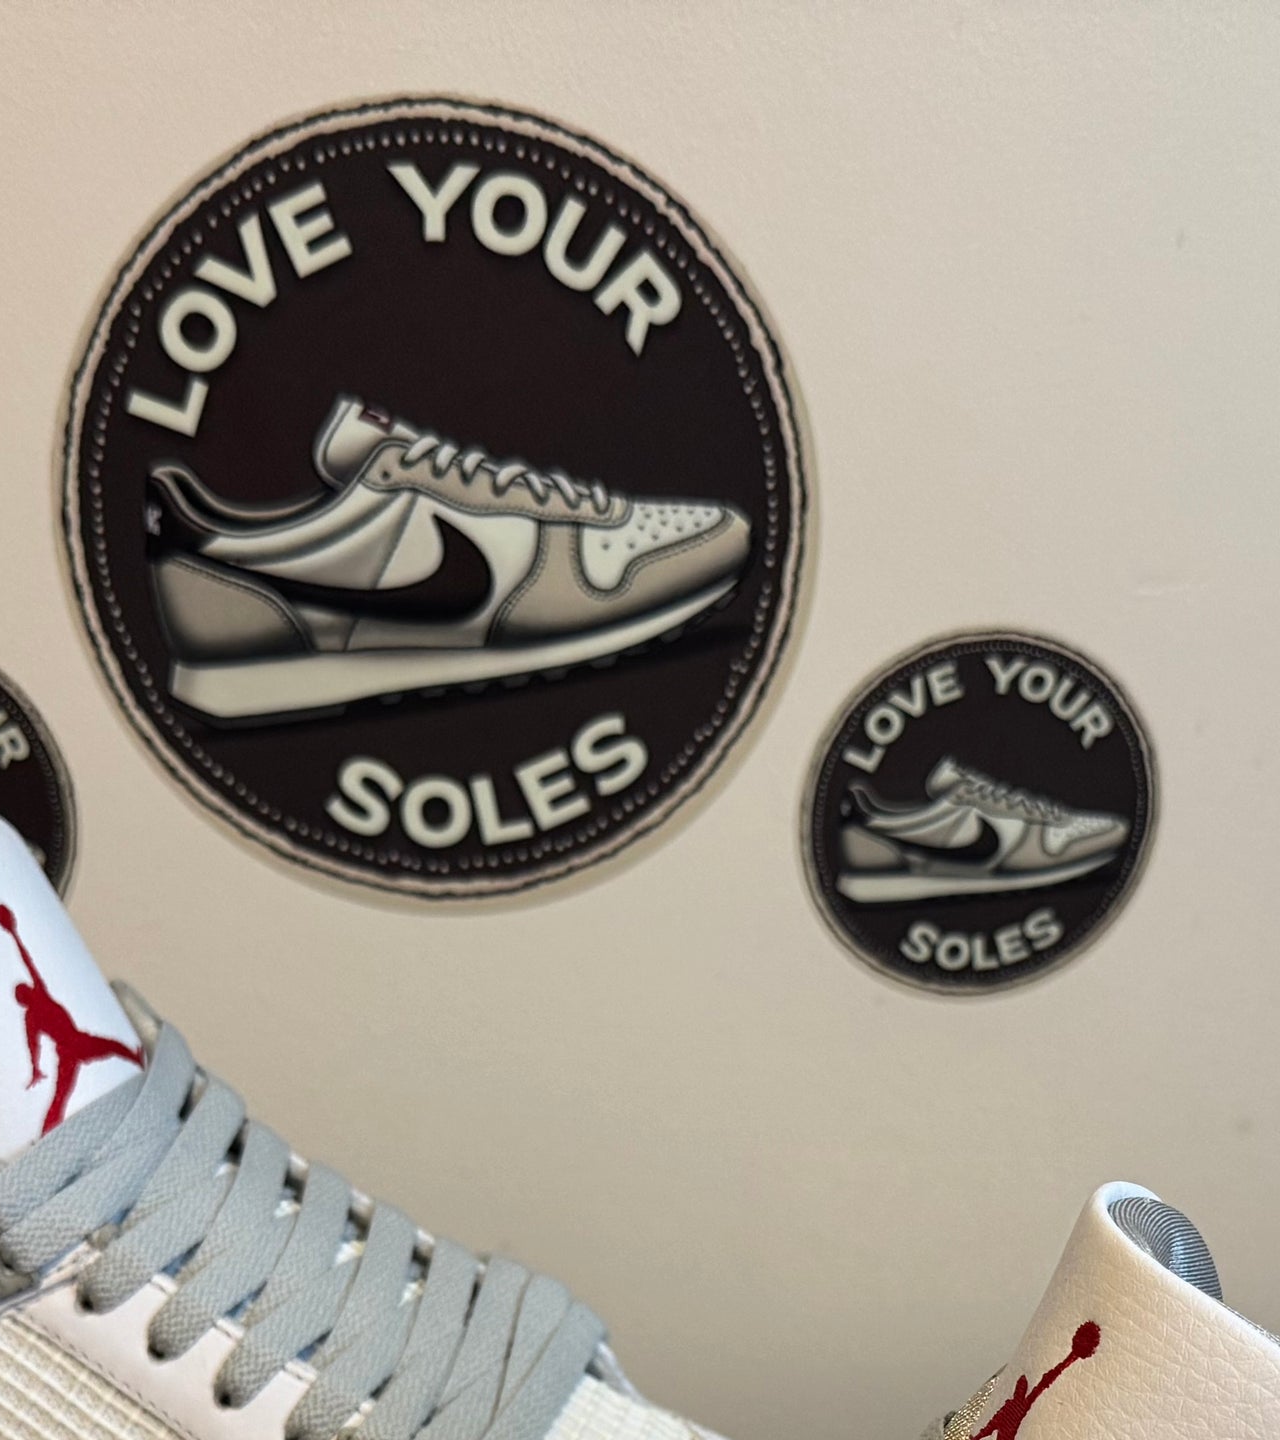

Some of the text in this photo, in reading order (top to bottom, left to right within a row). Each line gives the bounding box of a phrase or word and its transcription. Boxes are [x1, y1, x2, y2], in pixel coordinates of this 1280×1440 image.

[127, 163, 682, 438] LOVE YOUR
[843, 656, 1113, 773] LOVE YOUR
[327, 715, 648, 848] SOLES
[900, 908, 1063, 970] SOLES
